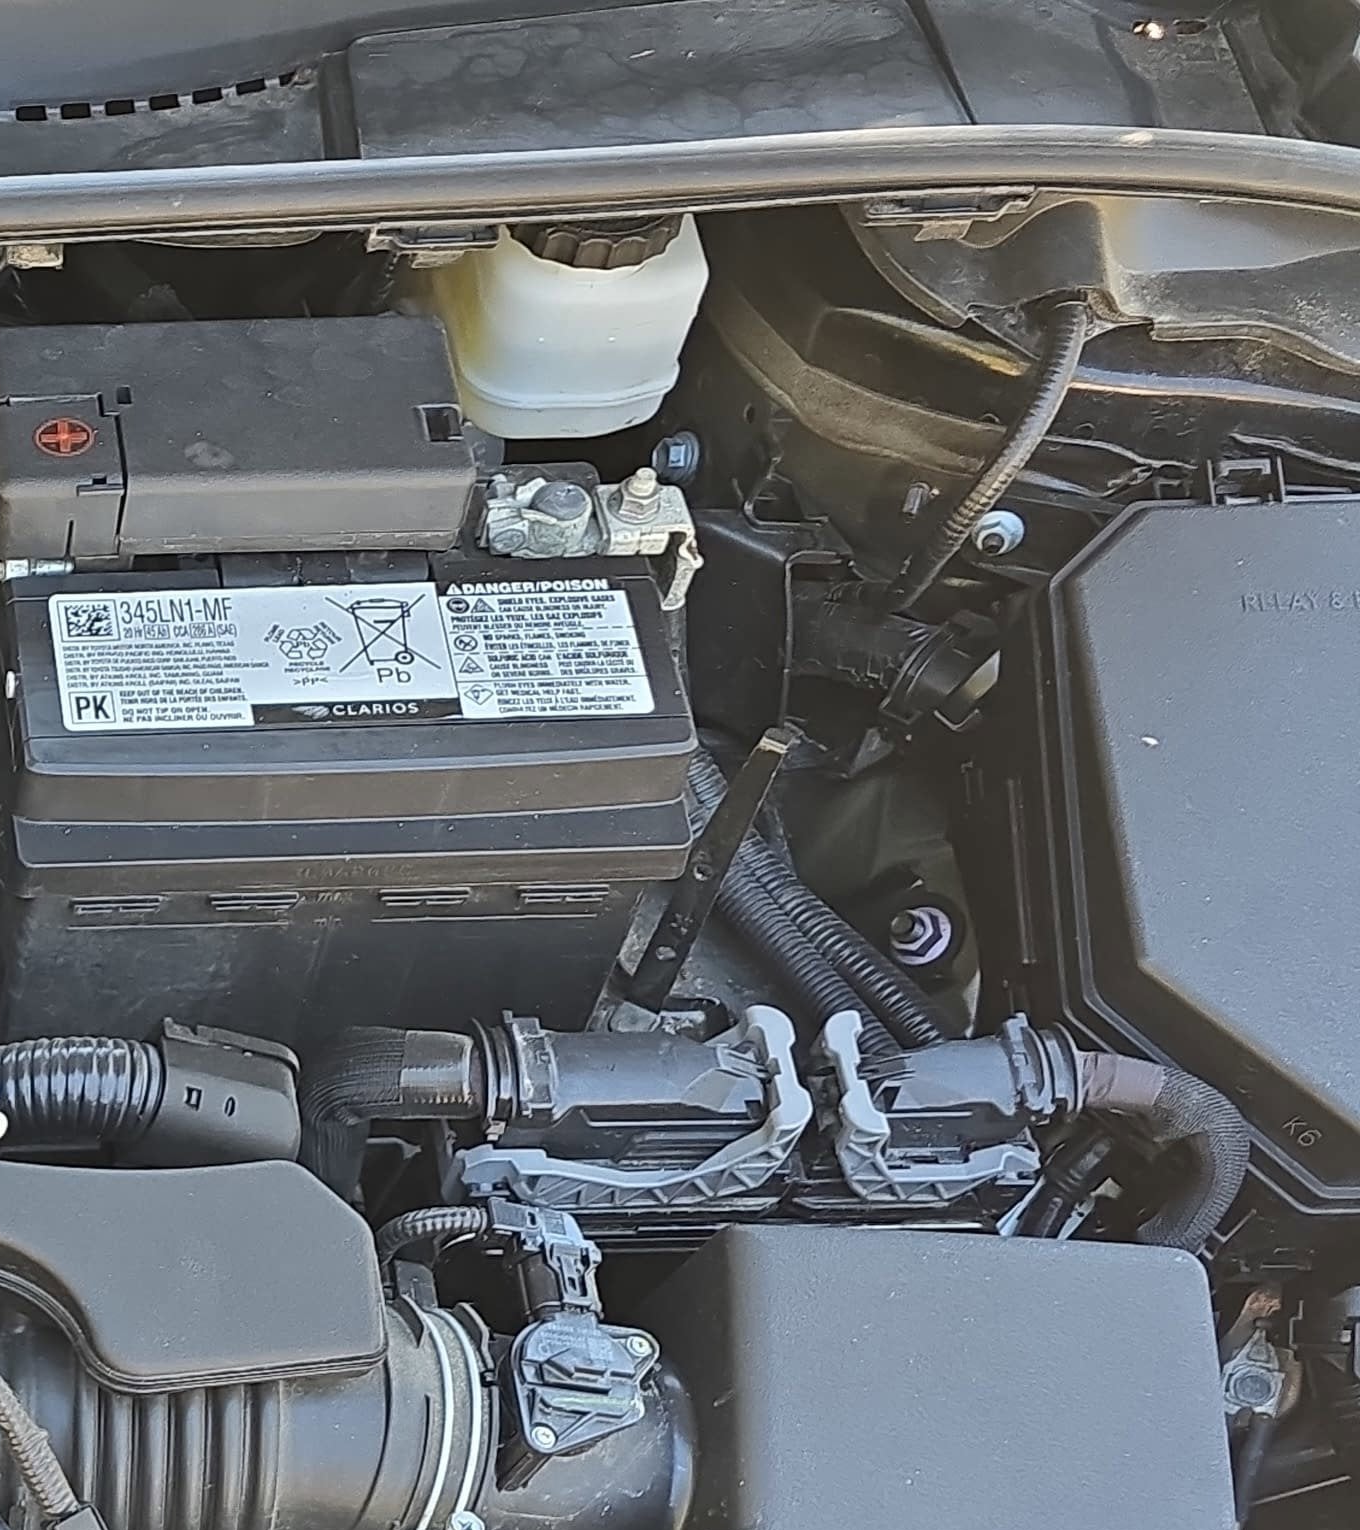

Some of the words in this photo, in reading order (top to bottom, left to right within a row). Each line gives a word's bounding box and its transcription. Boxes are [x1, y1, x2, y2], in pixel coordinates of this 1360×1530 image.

[462, 579, 608, 594] DANGER/POISON
[120, 597, 232, 625] 345LN1-MF
[376, 667, 412, 683] Pb
[75, 695, 110, 720] PK
[332, 702, 419, 717] CLARIOS
[1282, 1115, 1322, 1147] K6
